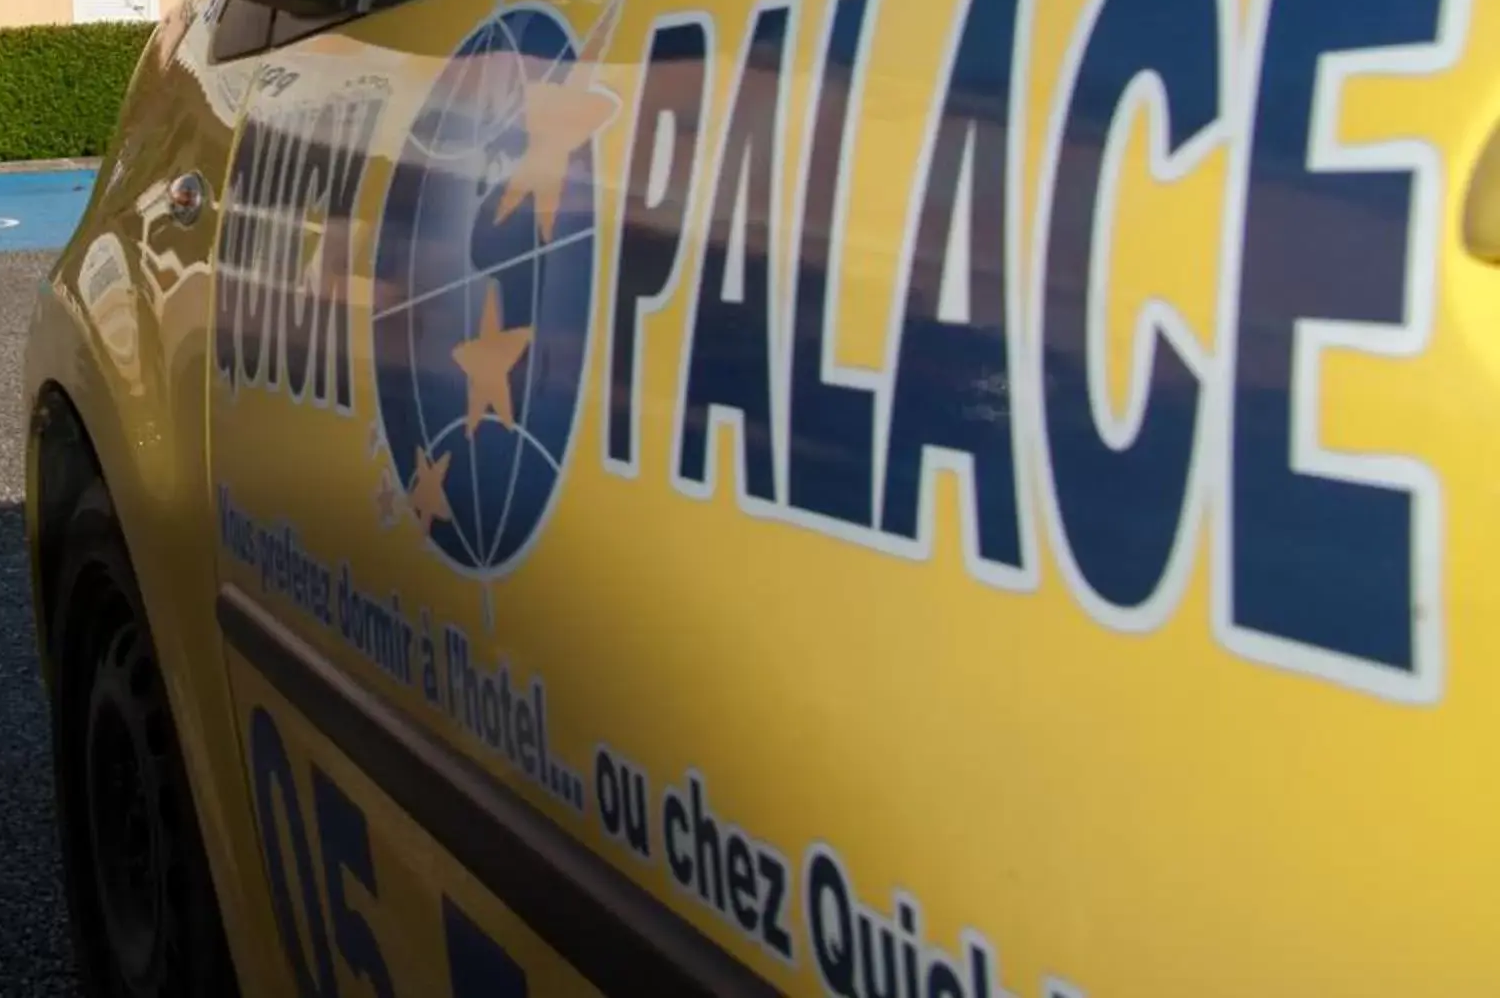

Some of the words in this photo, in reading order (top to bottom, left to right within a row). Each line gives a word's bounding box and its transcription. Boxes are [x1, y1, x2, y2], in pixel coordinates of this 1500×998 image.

[211, 94, 388, 418] QUICK
[337, 560, 414, 686] dormir
[595, 747, 651, 858] ou
[662, 775, 794, 960] chez
